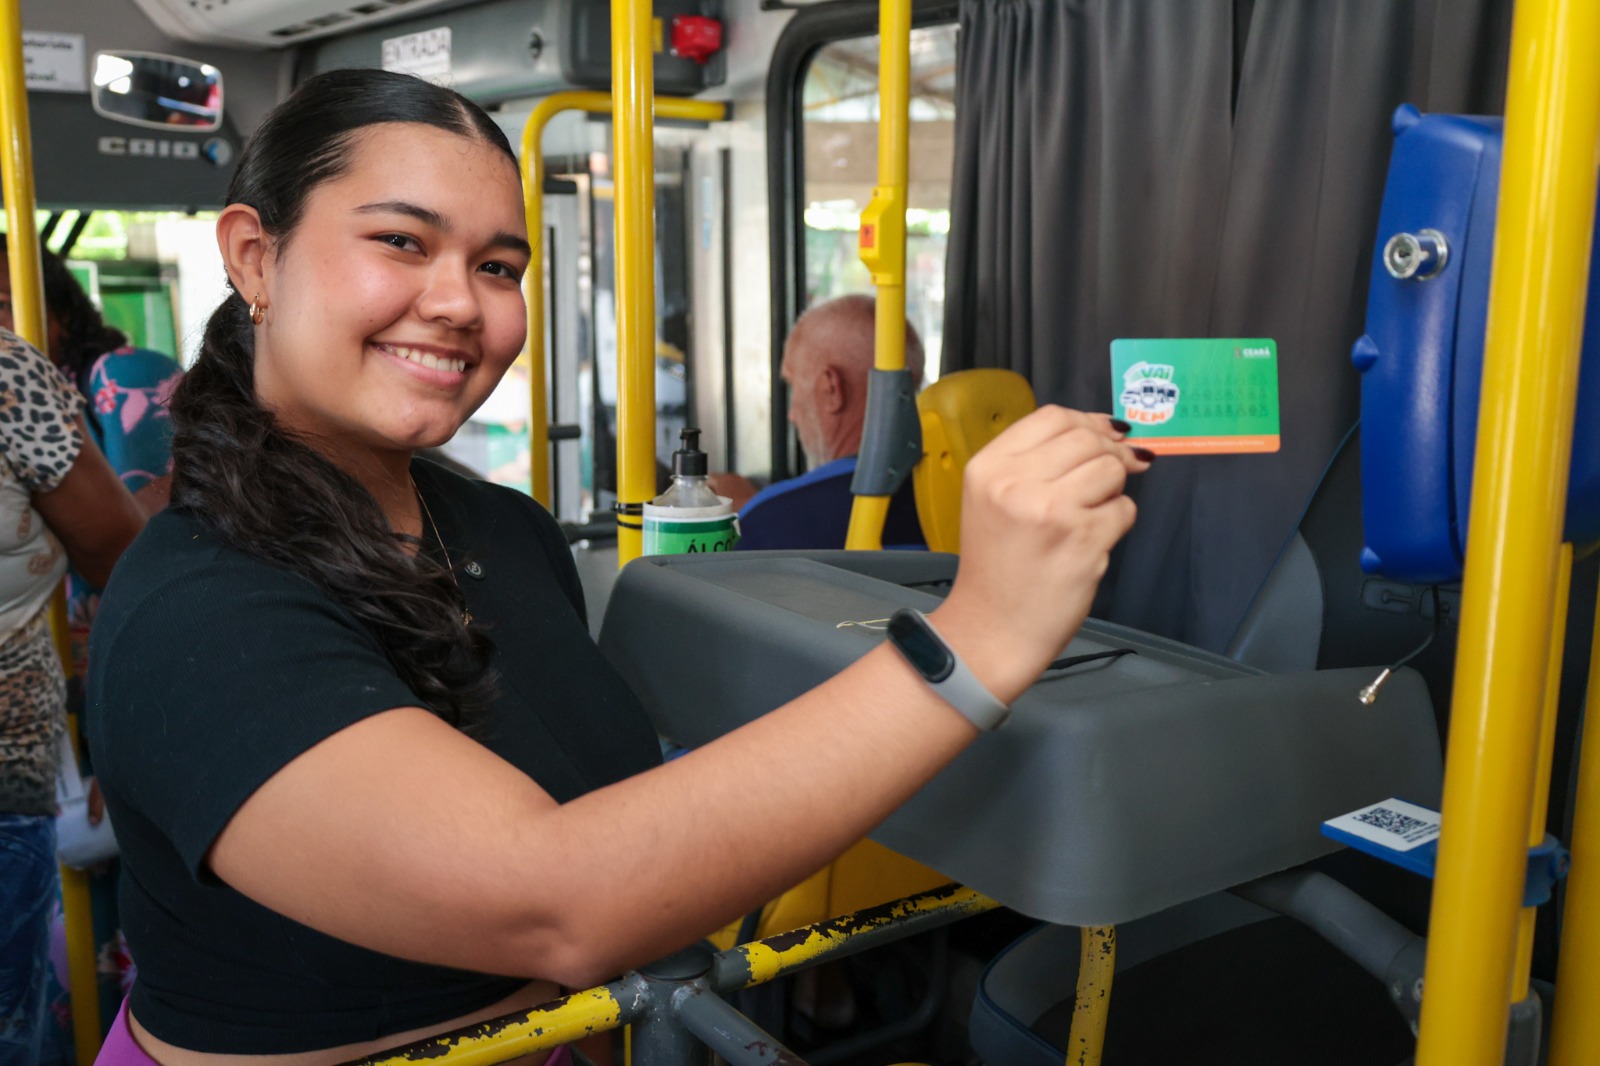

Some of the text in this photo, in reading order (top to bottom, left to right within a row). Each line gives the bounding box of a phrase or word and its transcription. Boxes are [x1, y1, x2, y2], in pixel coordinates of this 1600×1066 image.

[383, 32, 449, 65] ENTRADA
[99, 137, 198, 158] CAIO
[1127, 407, 1165, 421] VEM
